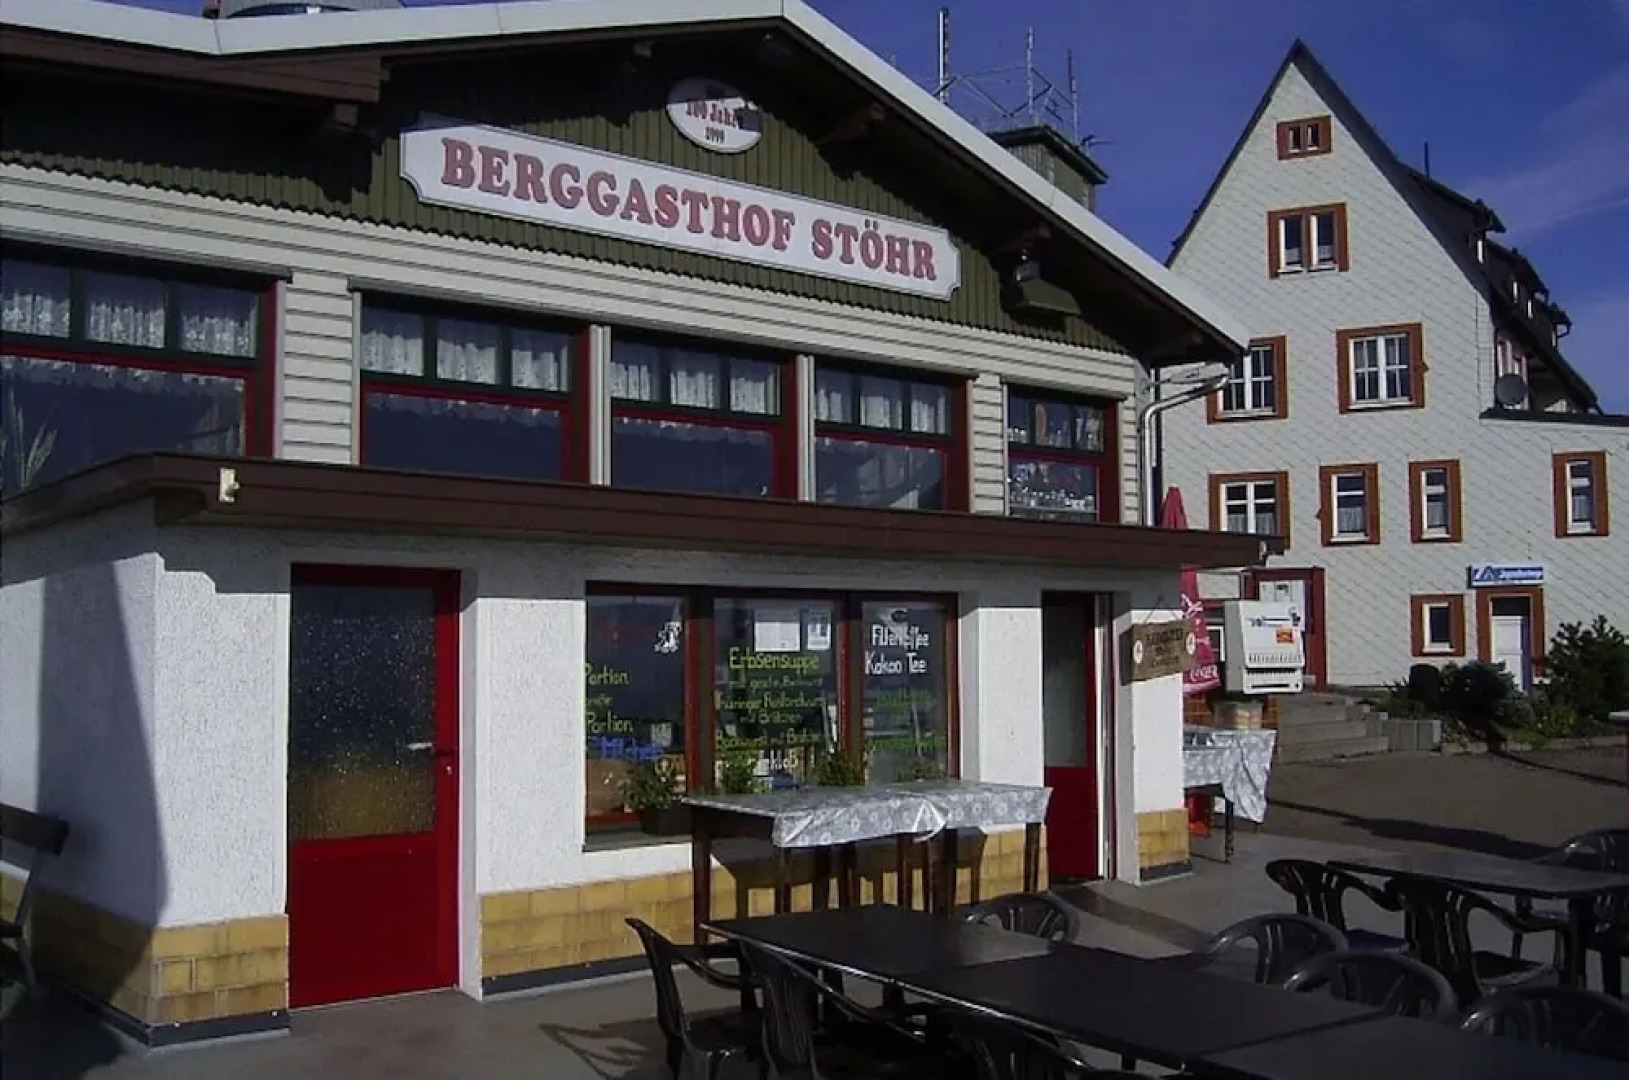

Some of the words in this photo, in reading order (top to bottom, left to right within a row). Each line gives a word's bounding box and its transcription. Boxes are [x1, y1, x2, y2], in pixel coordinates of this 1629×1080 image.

[440, 136, 795, 250] BERGGASTHOF
[810, 219, 937, 281] STÖHR
[728, 646, 820, 676] Erbsensuppe
[864, 651, 903, 675] Kakao
[905, 652, 927, 674] Tee
